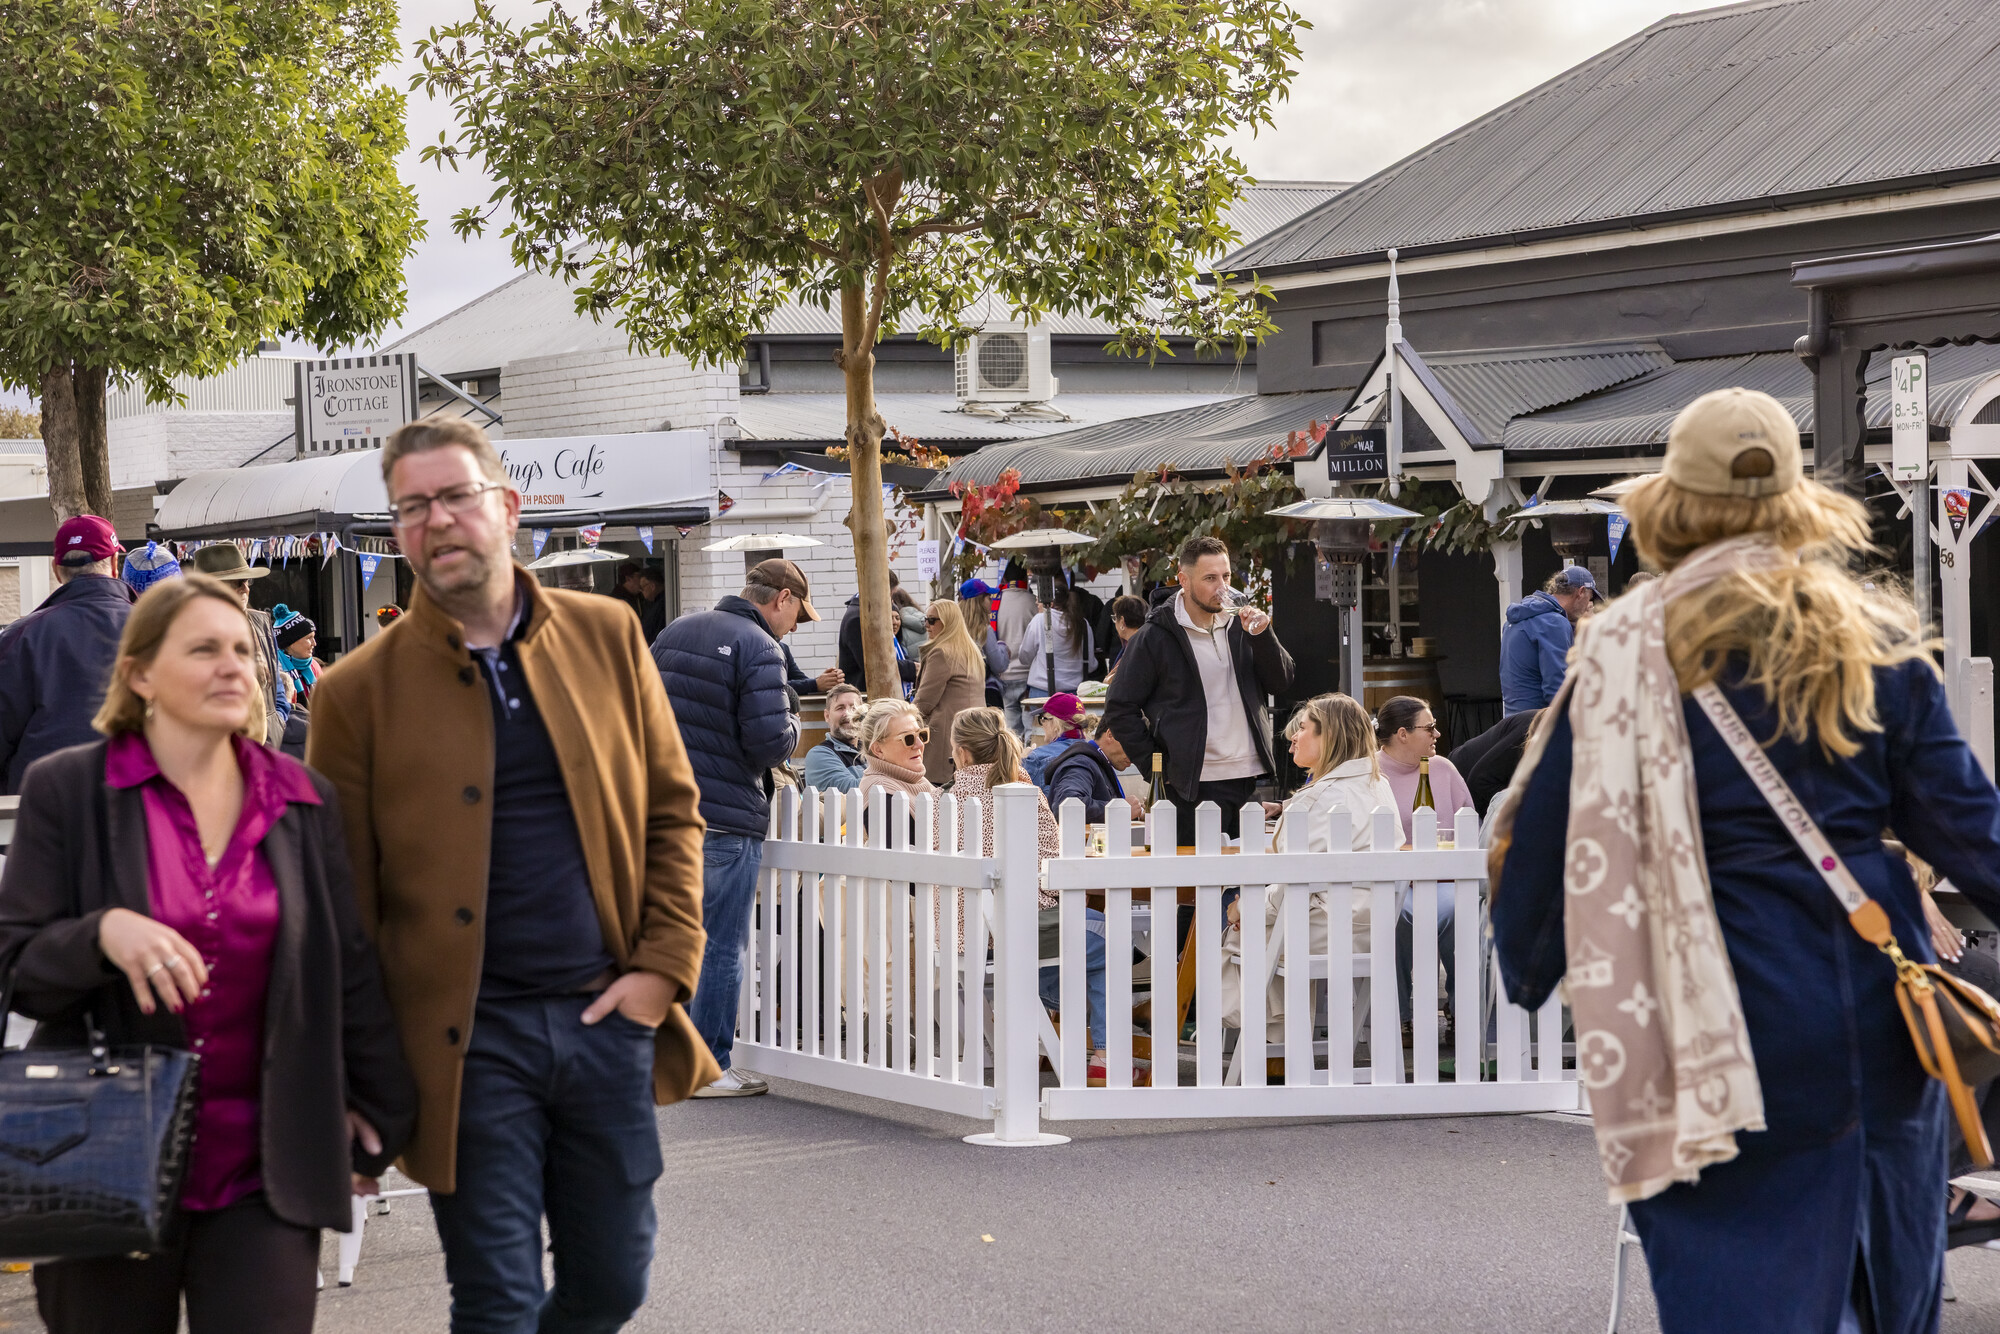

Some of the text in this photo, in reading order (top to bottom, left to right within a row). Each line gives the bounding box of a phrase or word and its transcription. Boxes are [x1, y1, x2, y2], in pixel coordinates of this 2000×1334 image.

[314, 374, 398, 398] IRONSTONE
[323, 395, 389, 418] COTTAGE
[1357, 440, 1374, 452] WAR
[554, 444, 605, 490] Café
[1331, 459, 1383, 473] MILLON
[533, 494, 565, 505] PASSION
[1940, 547, 1955, 569] 58
[1702, 689, 1813, 836] LOUIS VUITTON
